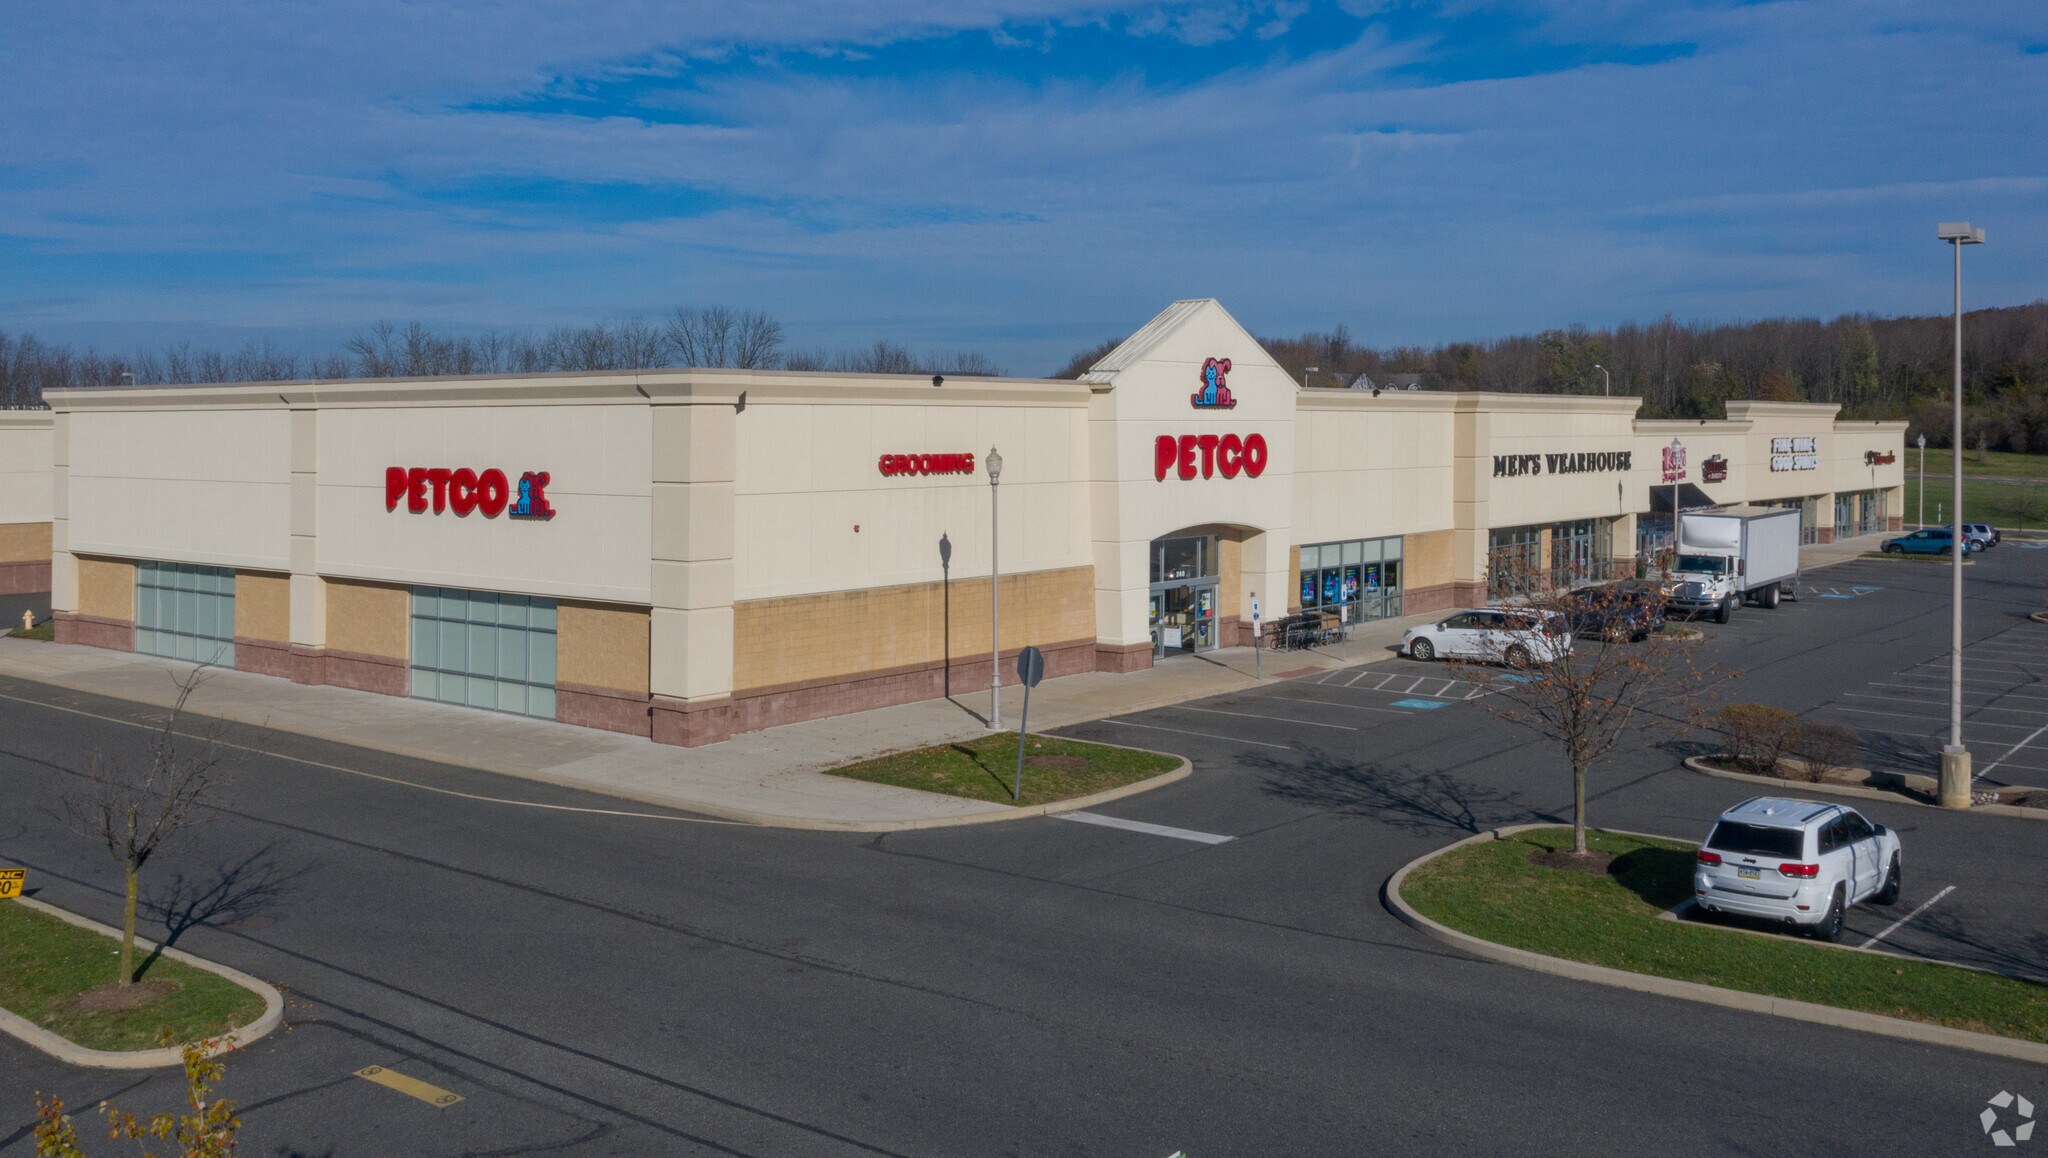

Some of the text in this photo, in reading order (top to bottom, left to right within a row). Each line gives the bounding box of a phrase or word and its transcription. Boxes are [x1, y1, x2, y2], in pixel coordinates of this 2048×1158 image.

[878, 453, 975, 476] GROOMING
[1155, 433, 1267, 481] PETCO
[1493, 451, 1632, 477] MEN'S WEARHOUSE
[386, 466, 508, 519] PETCO
[0, 881, 12, 894] 0
